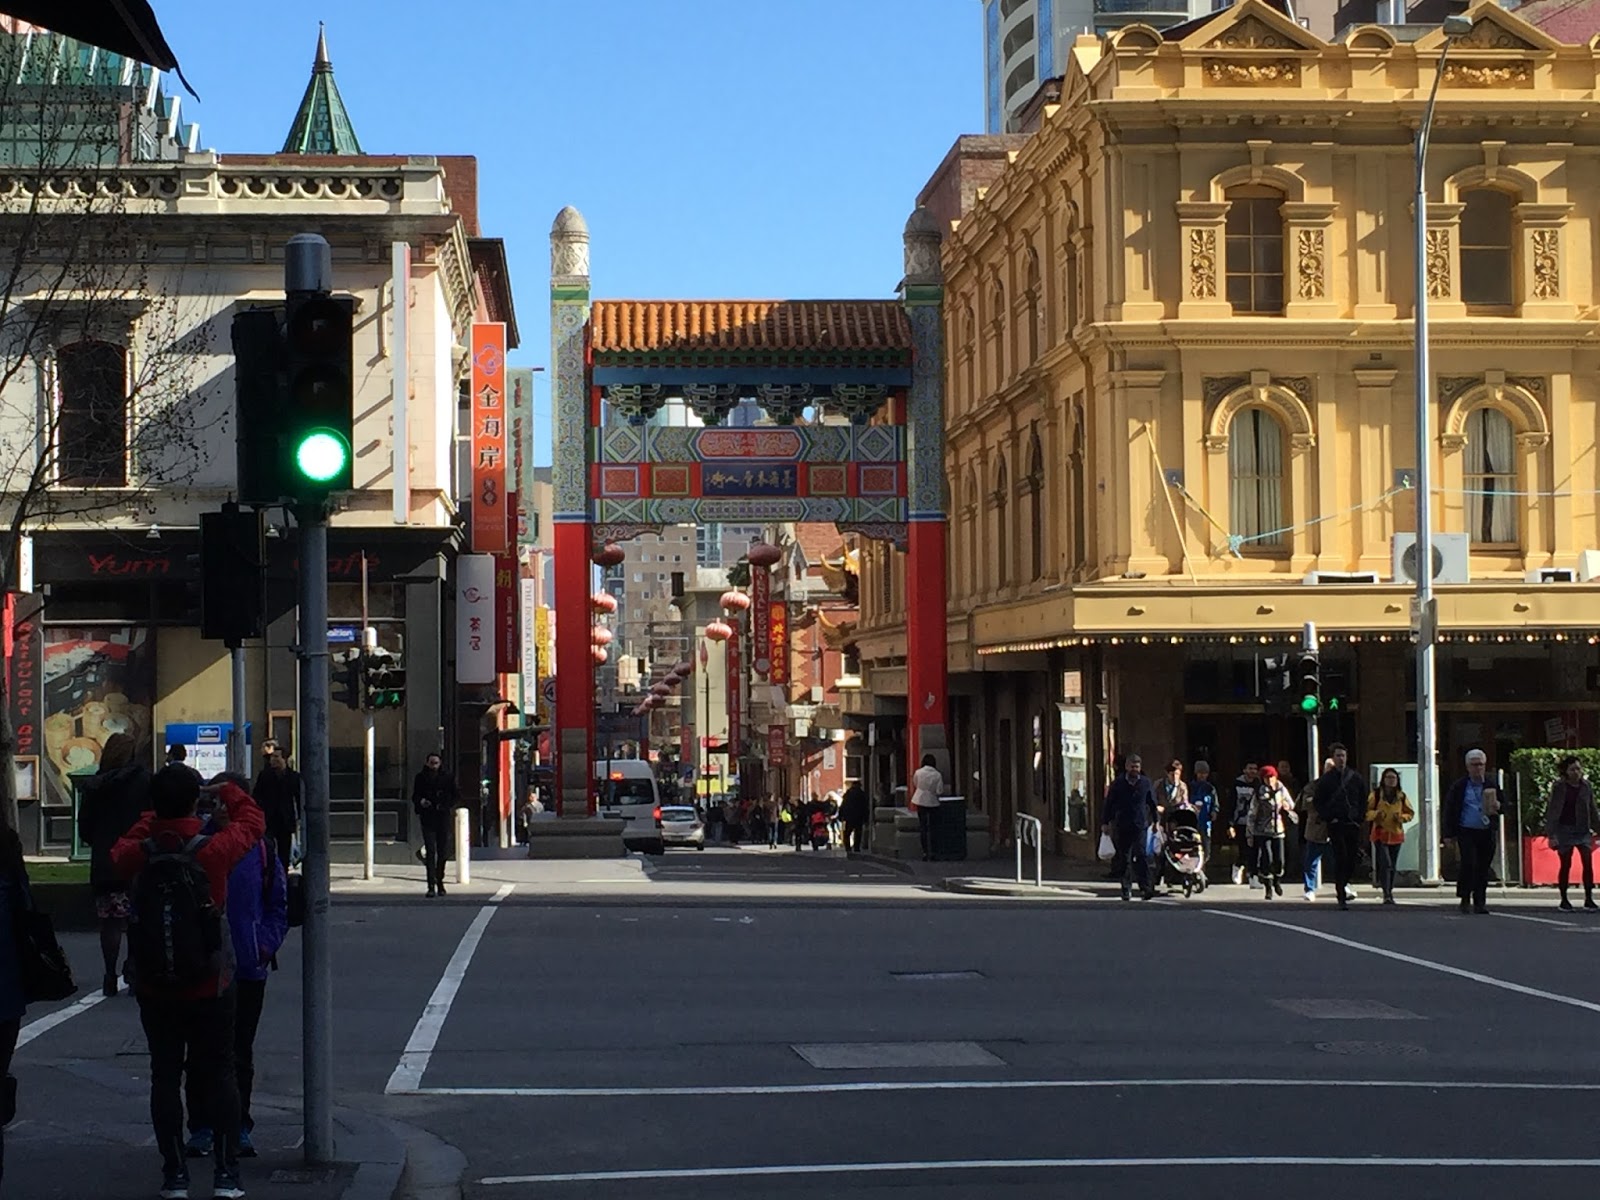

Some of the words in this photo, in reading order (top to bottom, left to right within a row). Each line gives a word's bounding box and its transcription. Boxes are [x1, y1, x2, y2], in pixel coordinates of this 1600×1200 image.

[475, 383, 502, 470] 金海岸
[88, 553, 170, 575] Yum
[524, 584, 532, 602] THE
[525, 605, 533, 643] DESSERT
[525, 647, 534, 688] KITCHEN
